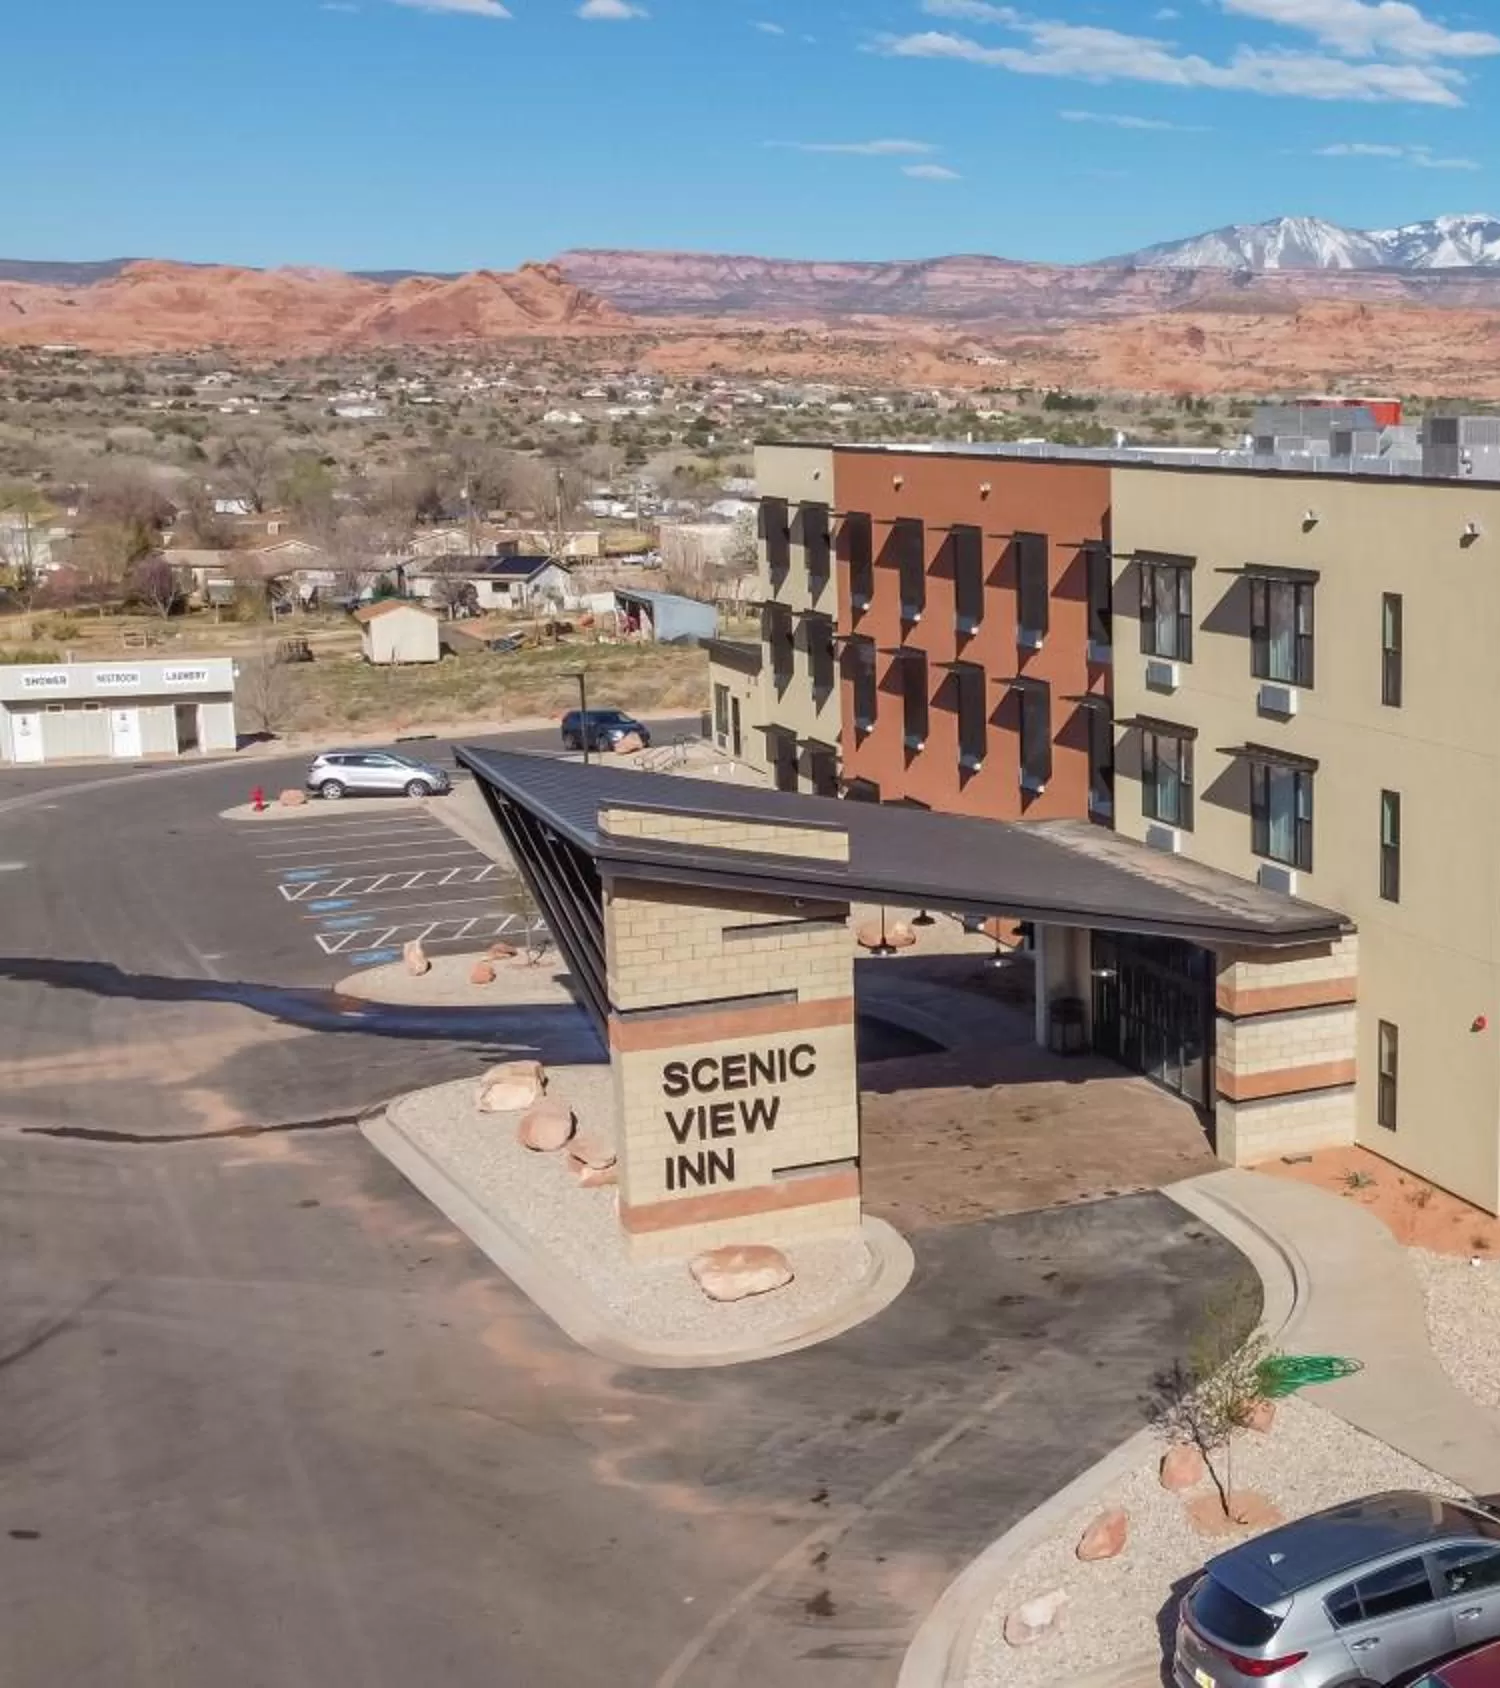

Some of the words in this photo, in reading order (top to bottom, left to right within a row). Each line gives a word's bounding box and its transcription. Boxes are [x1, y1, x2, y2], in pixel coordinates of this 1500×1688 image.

[663, 1044, 816, 1097] SCENIC
[665, 1096, 780, 1144] VIEW
[665, 1148, 736, 1190] INN
